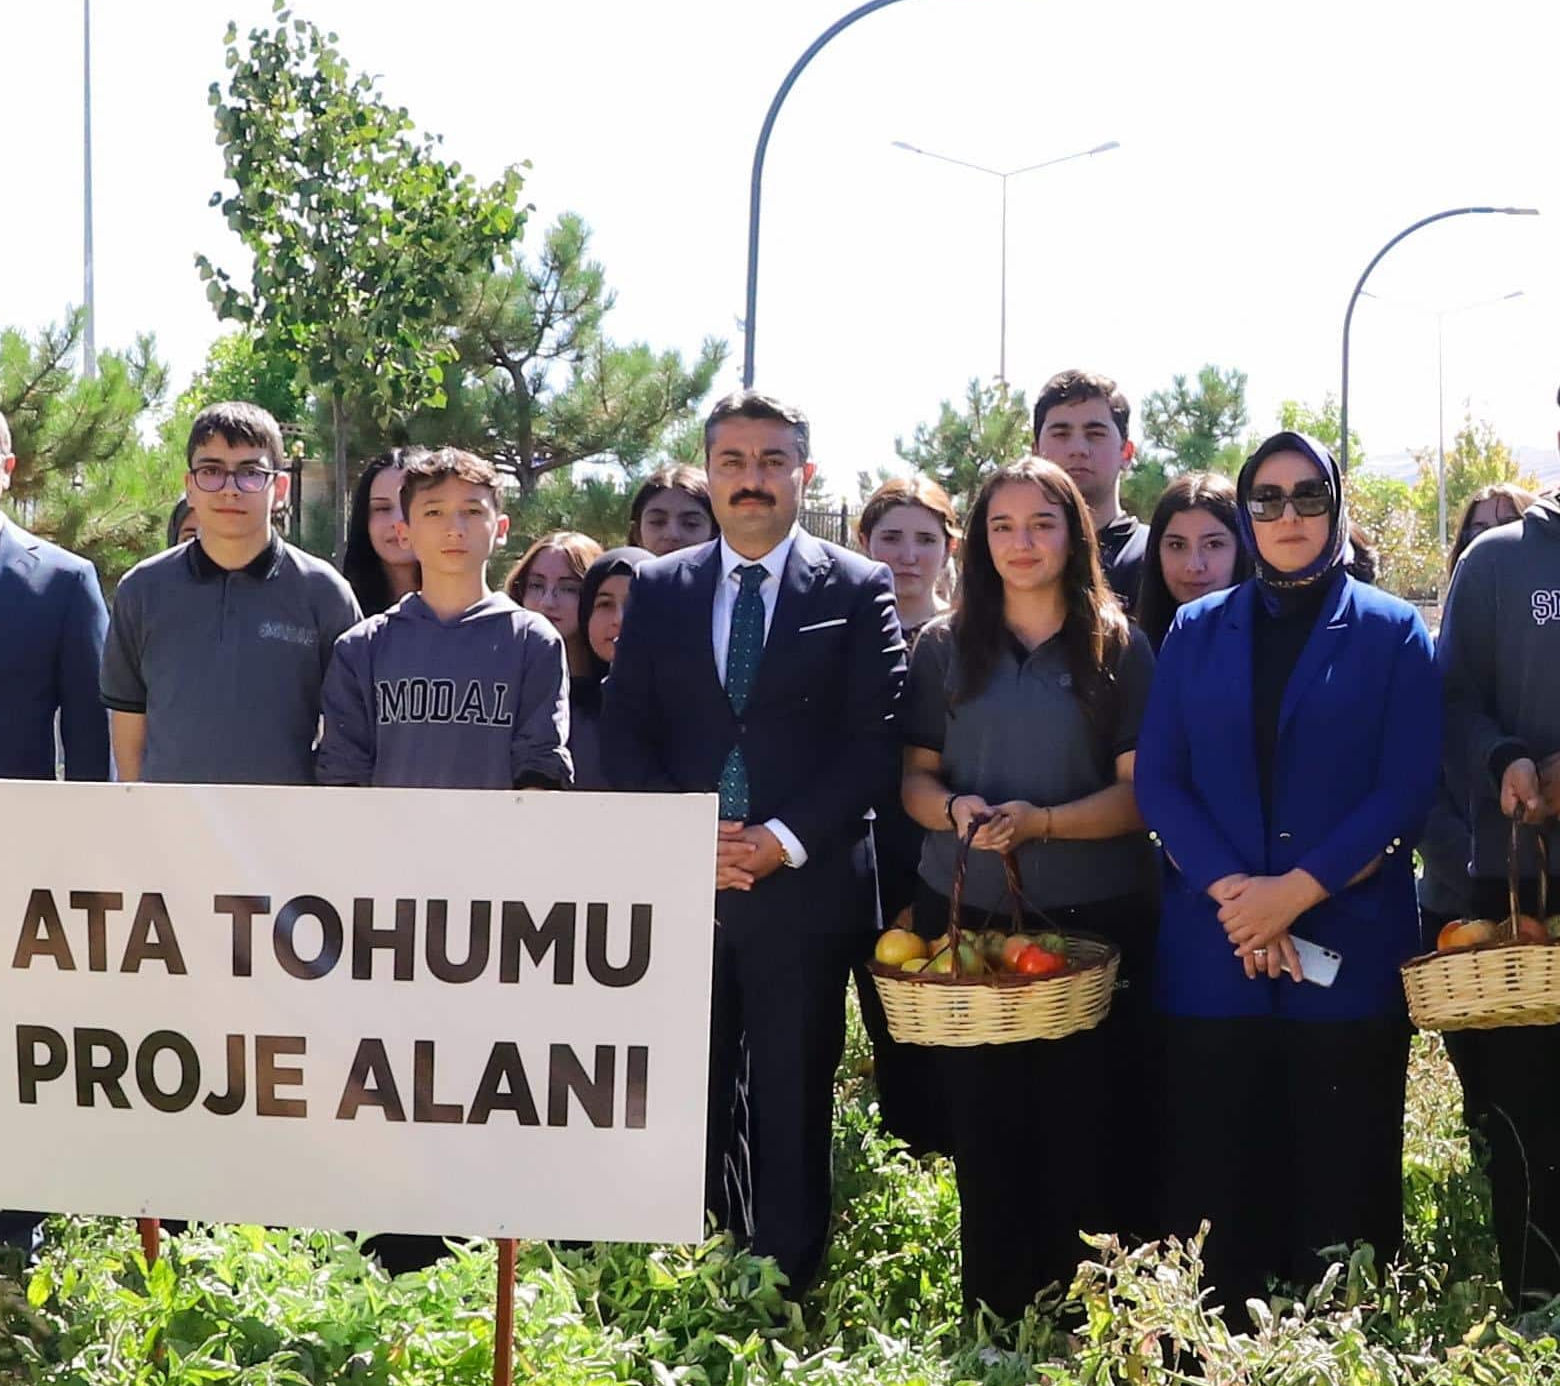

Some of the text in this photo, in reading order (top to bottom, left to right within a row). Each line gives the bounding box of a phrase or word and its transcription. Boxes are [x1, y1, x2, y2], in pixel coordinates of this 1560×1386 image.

[375, 676, 513, 727] MODAL
[11, 888, 653, 988] ATA TOHUMU
[15, 1024, 649, 1130] PROJE ALANI
